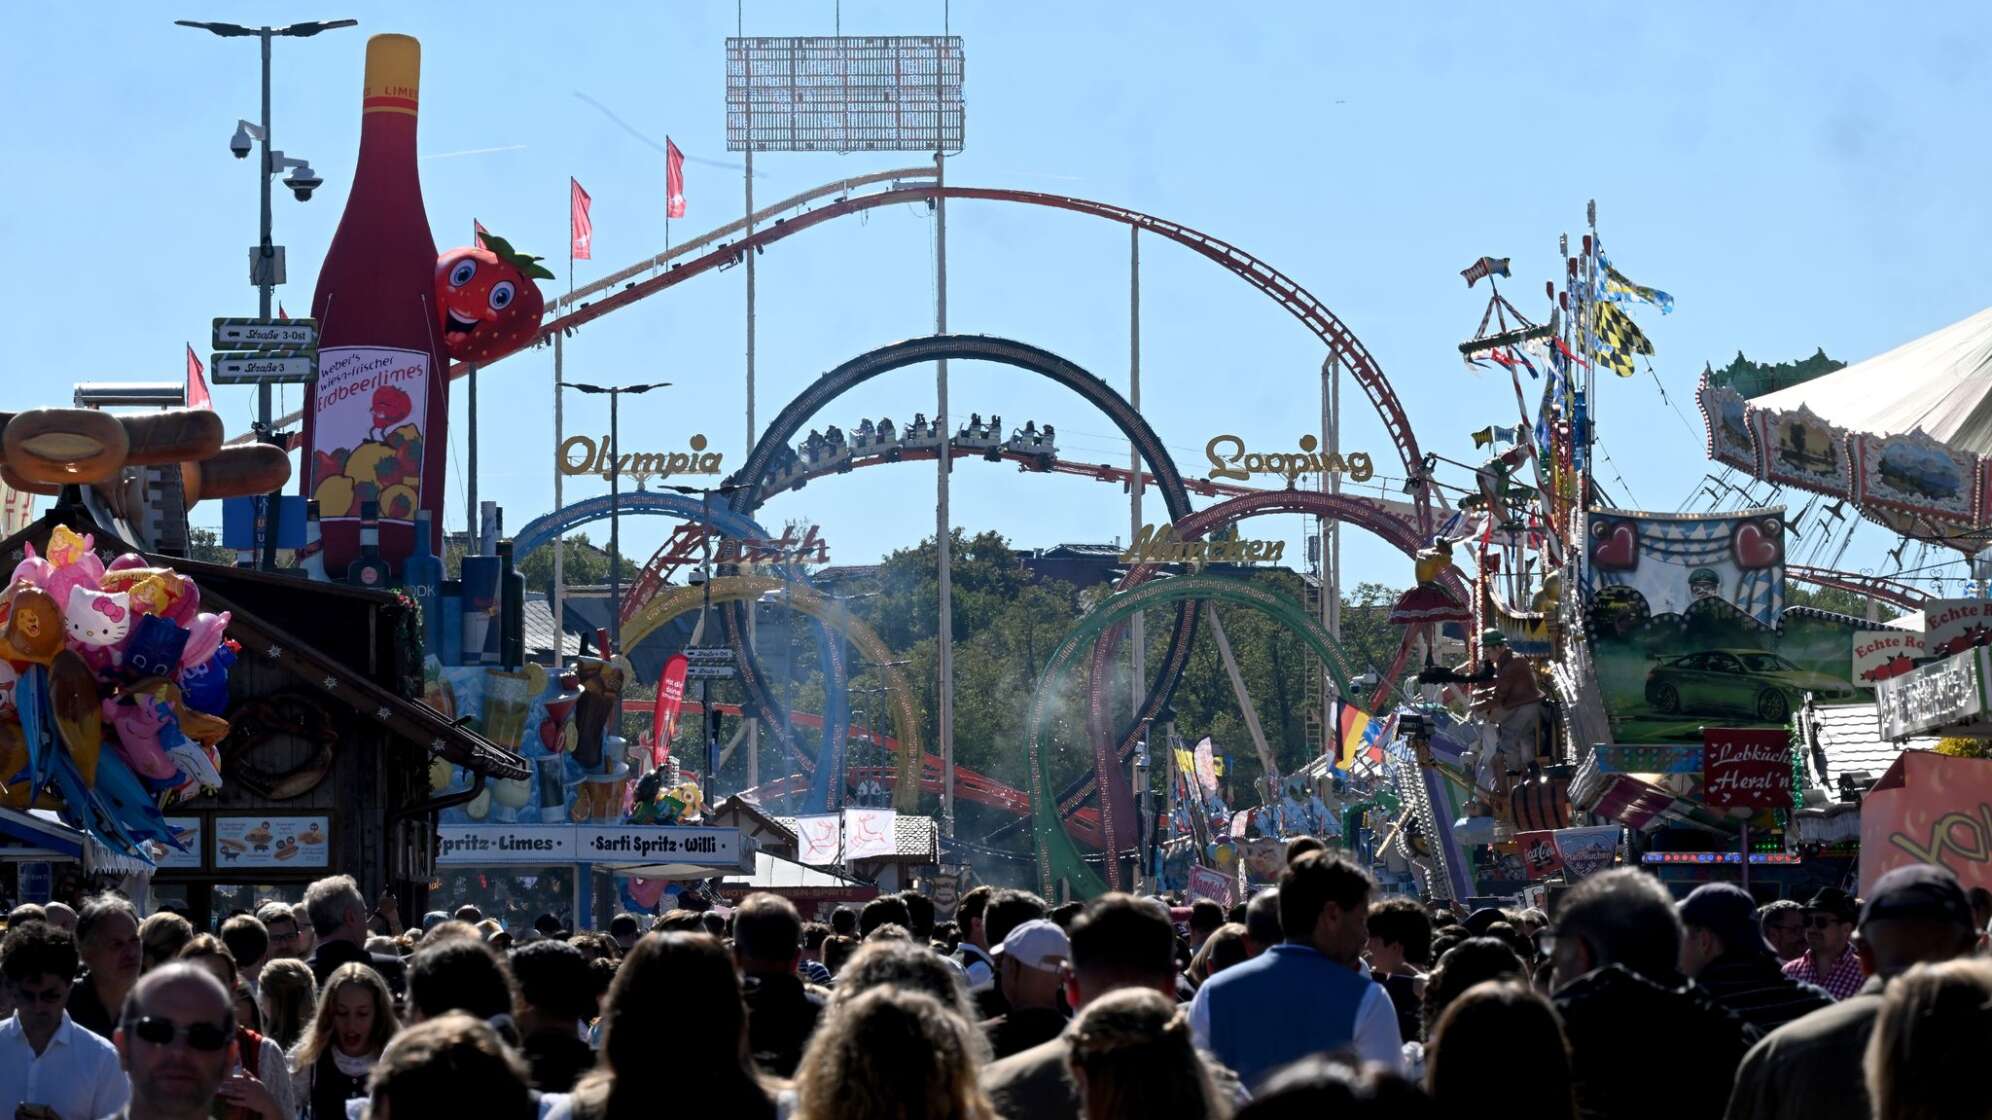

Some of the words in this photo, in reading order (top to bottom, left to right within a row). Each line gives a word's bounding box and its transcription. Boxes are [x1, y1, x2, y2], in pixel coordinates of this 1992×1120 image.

[246, 329, 279, 340] Straße
[283, 331, 306, 340] 3-Ost
[244, 363, 278, 373] Straße
[279, 364, 285, 372] 3
[317, 363, 424, 413] Erdbeerlimes
[559, 434, 723, 482] Olympia
[1206, 434, 1374, 483] Looping
[1927, 605, 1978, 630] Echte
[1855, 638, 1900, 658] Echte
[1905, 635, 1926, 649] Ro
[438, 834, 490, 856] pritz
[499, 834, 553, 851] Limes
[633, 836, 677, 857] Spritz
[684, 836, 716, 853] Willi
